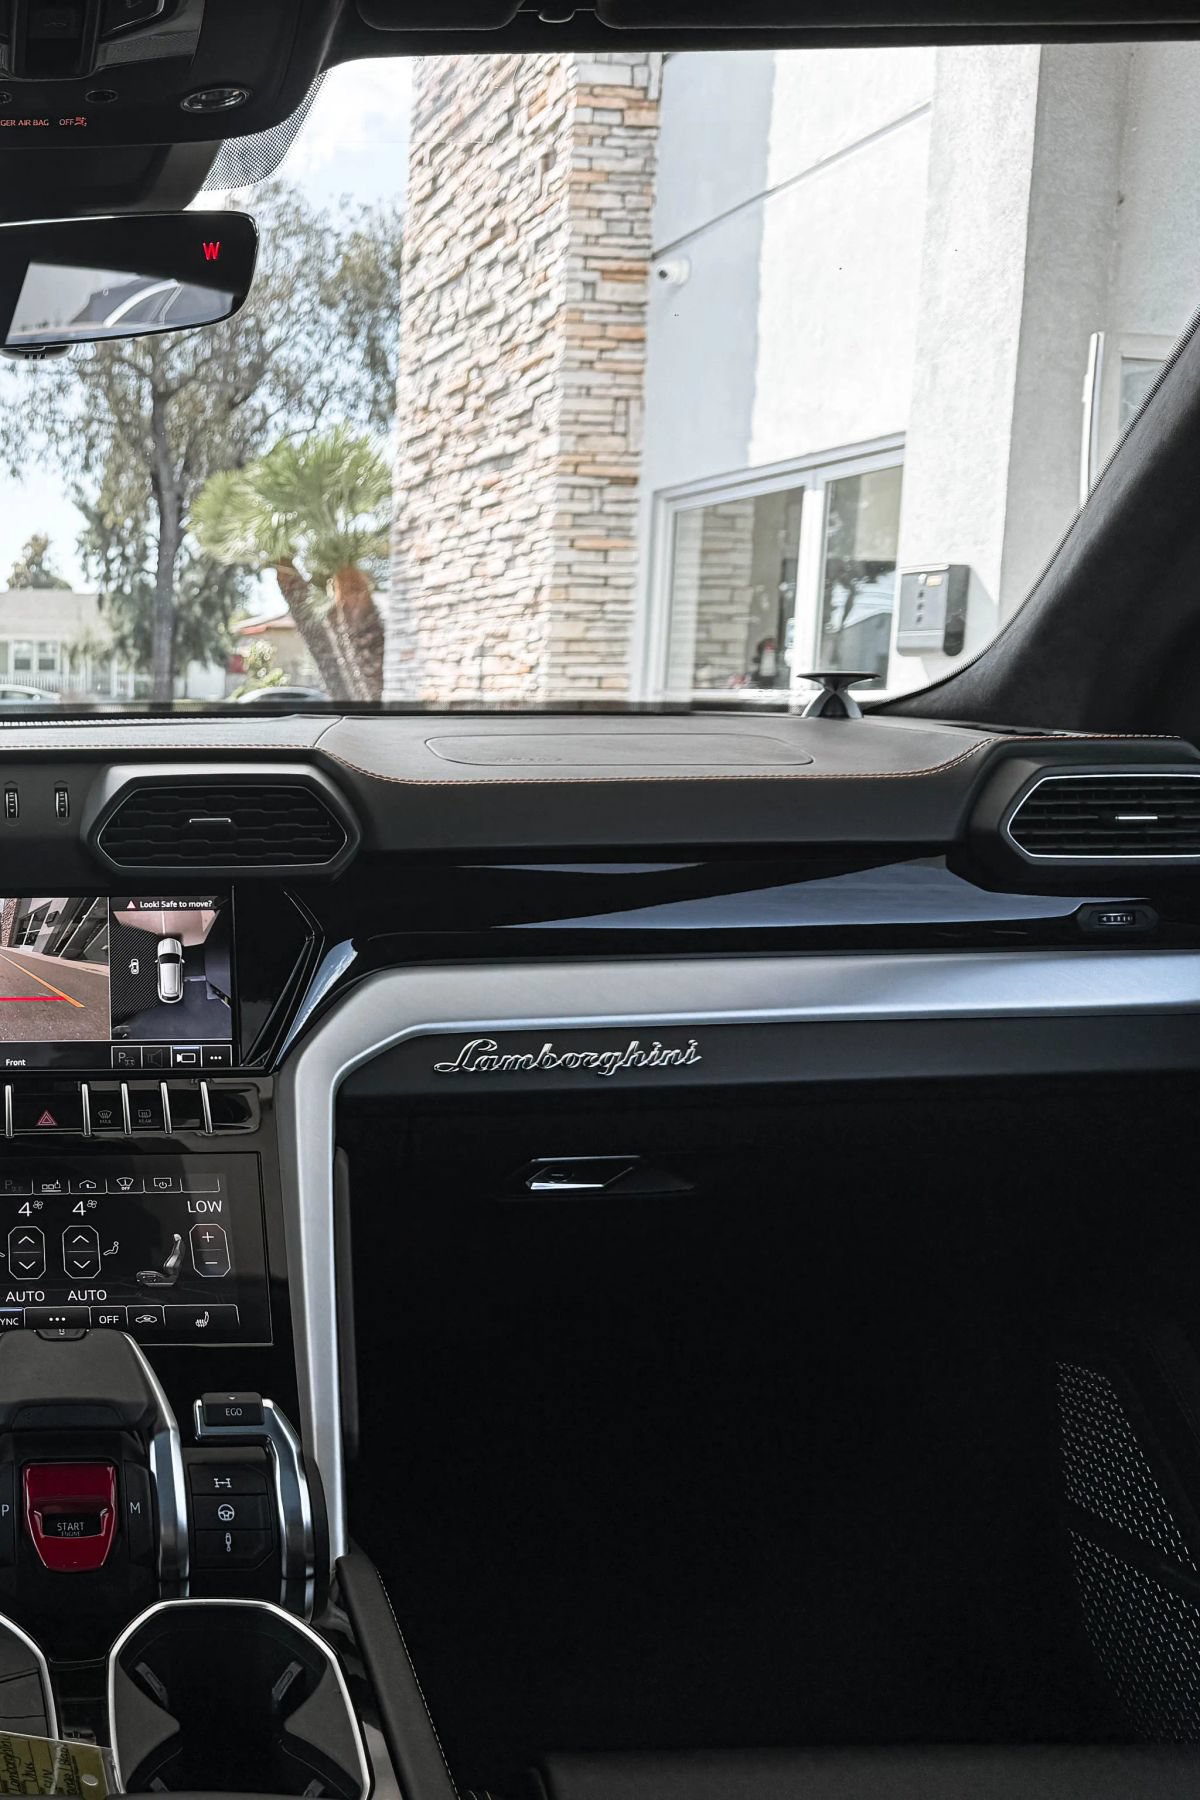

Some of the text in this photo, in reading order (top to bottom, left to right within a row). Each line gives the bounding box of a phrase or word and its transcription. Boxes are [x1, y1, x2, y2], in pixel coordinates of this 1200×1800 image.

[18, 119, 31, 127] AIR
[33, 119, 49, 127] BAG
[59, 118, 74, 126] OFF
[202, 241, 220, 261] W
[5, 1058, 26, 1066] Front
[434, 1038, 702, 1076] Lamborghini
[18, 1202, 33, 1217] 4
[72, 1201, 87, 1216] 4
[187, 1200, 222, 1213] LOW
[5, 1291, 45, 1302] AUTO
[67, 1290, 107, 1301] AUTO
[98, 1315, 119, 1324] OFF
[225, 1407, 243, 1416] EGO
[1, 1504, 10, 1517] P
[129, 1502, 141, 1514] M
[57, 1522, 84, 1531] START
